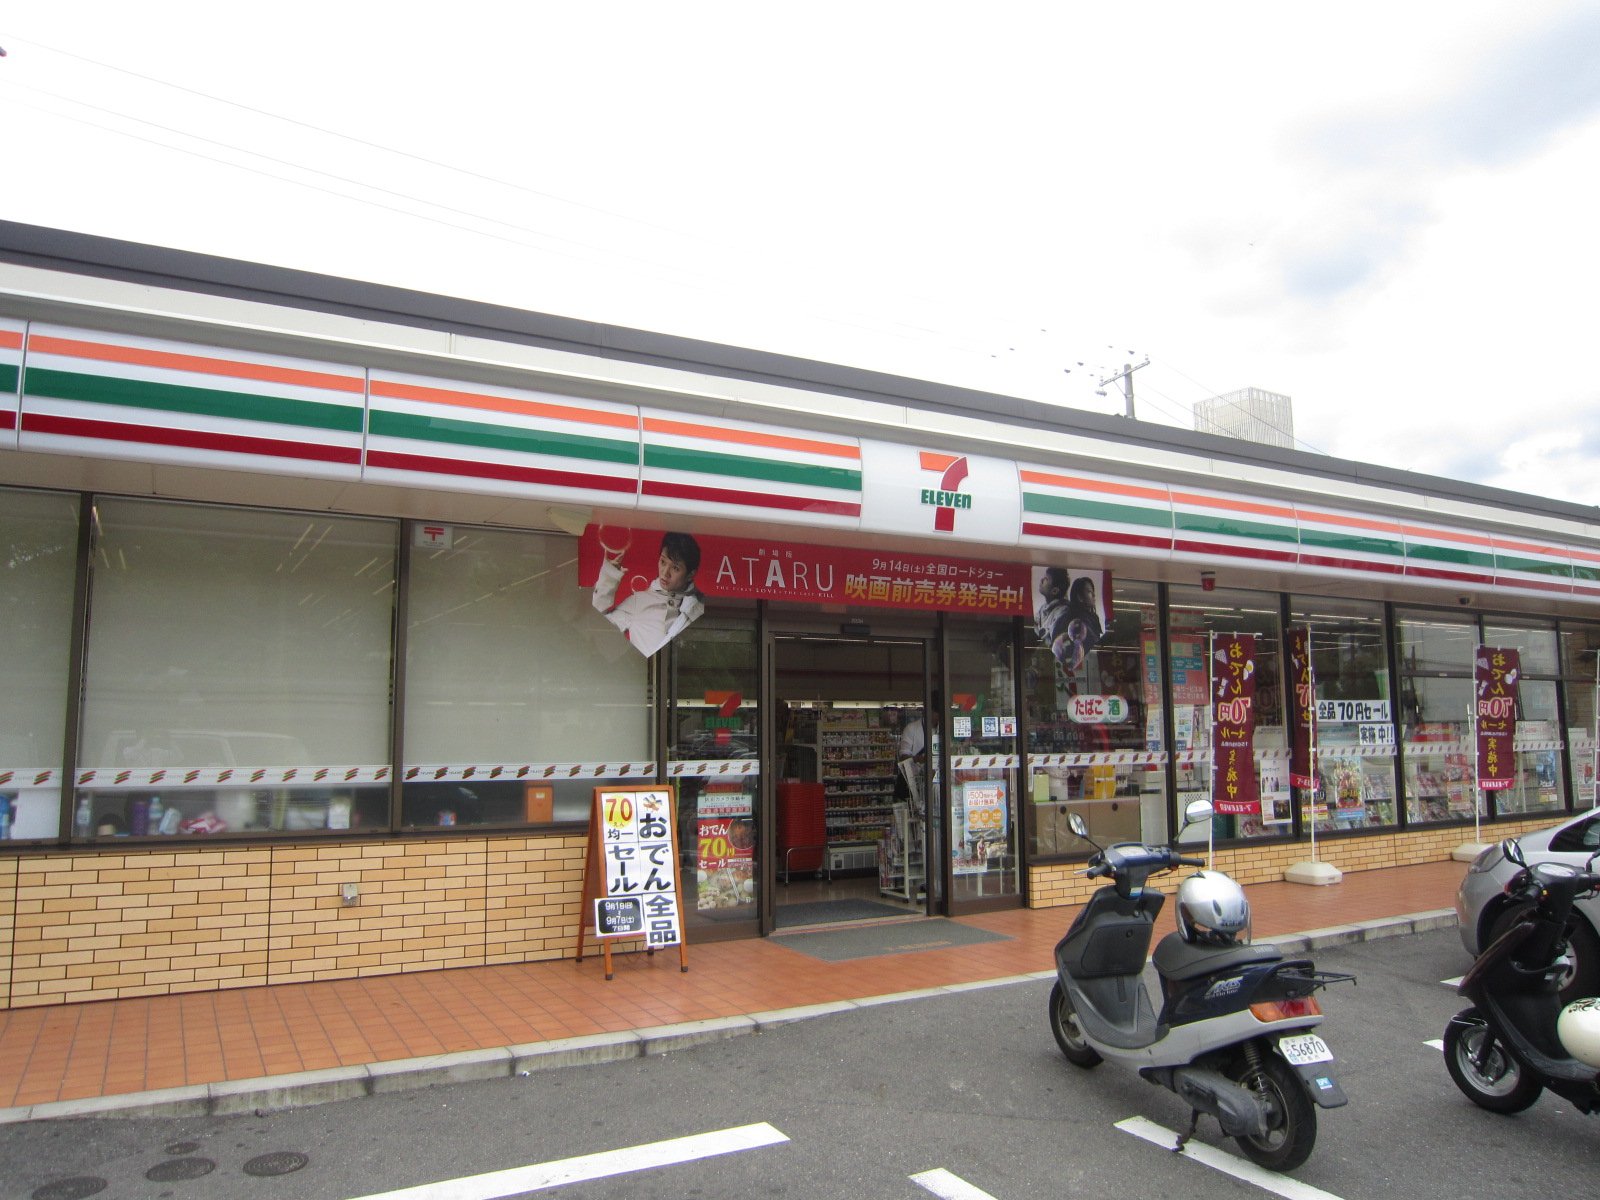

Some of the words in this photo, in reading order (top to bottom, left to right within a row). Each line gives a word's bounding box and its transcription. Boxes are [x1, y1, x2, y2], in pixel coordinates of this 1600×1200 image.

[919, 451, 968, 531] 7
[716, 555, 833, 592] ATARU
[1075, 699, 1104, 715] たばこ
[1108, 699, 1120, 716] 酒
[606, 798, 633, 822] 70
[607, 828, 634, 841] 均一
[699, 824, 728, 836] おでん
[607, 845, 639, 893] セール
[699, 859, 726, 869] セール
[1291, 1041, 1325, 1056] 56870
